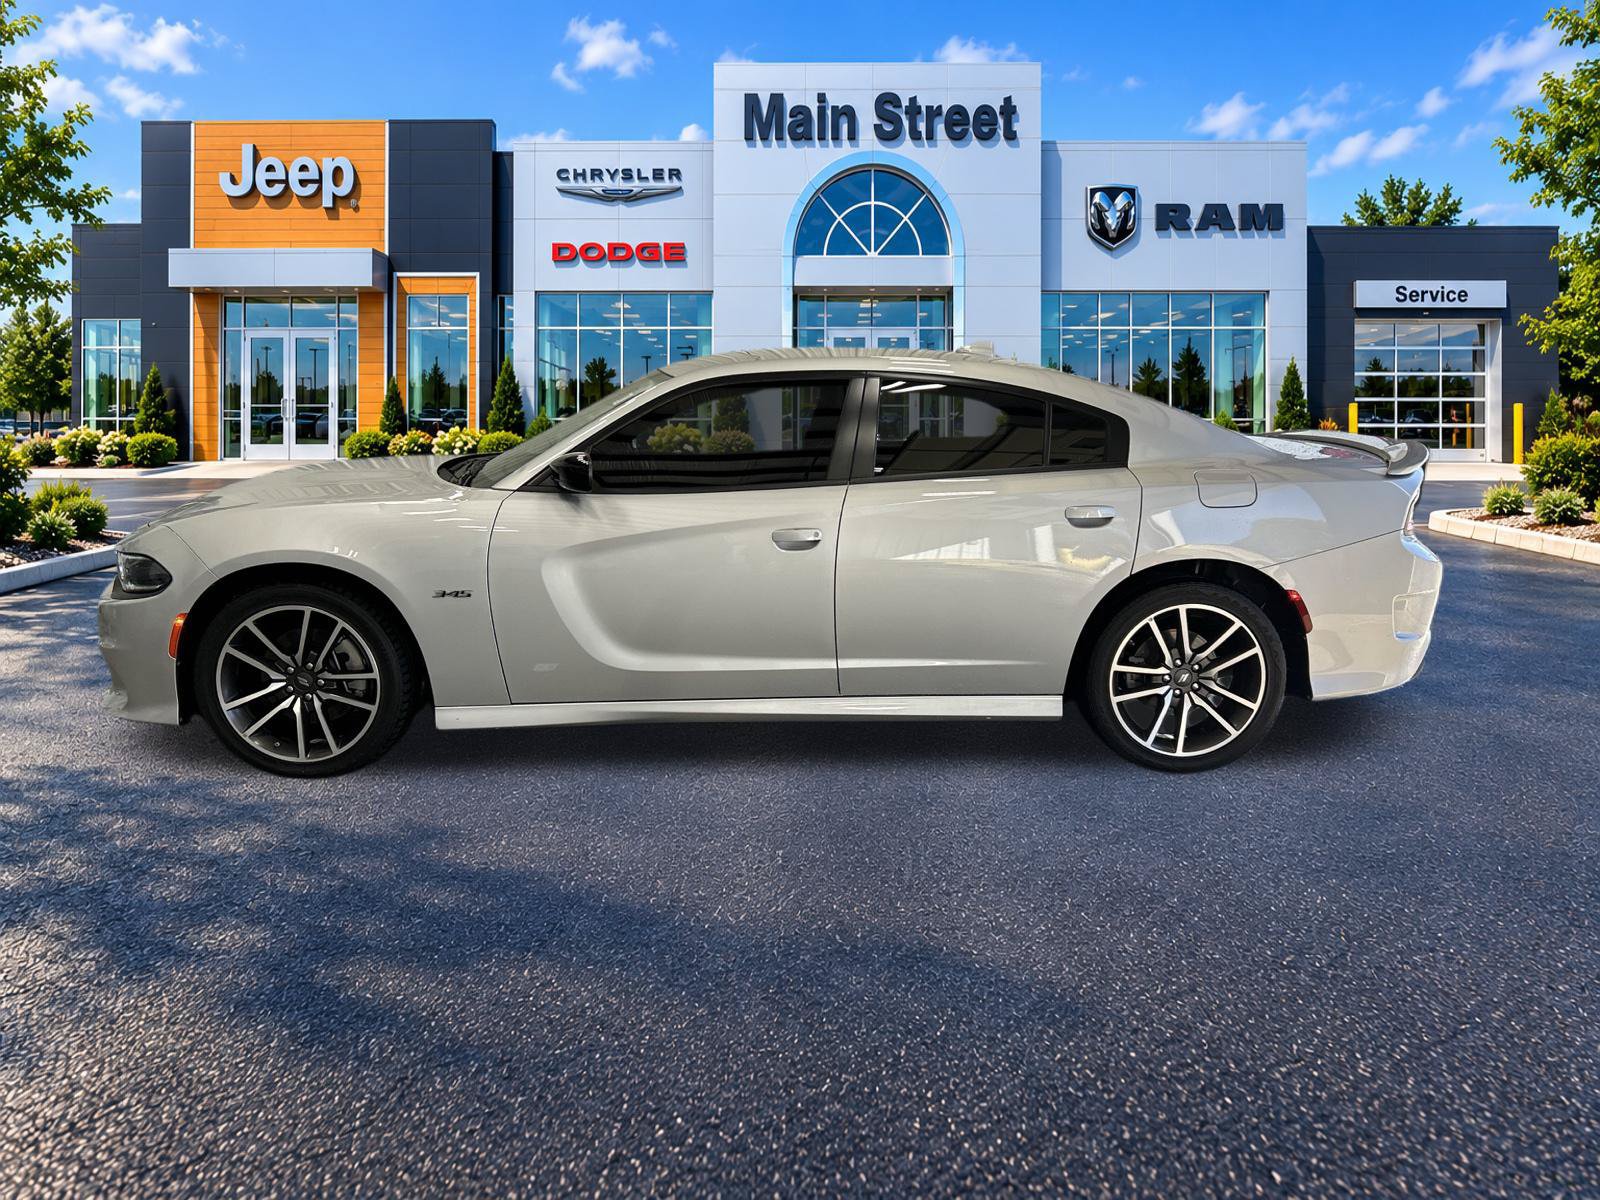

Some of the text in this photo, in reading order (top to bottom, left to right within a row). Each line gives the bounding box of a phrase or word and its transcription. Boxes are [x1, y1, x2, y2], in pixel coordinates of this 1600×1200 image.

[744, 92, 1017, 141] Main Street
[219, 144, 355, 208] Jeep
[556, 168, 682, 182] CHRYSLER
[1155, 203, 1284, 231] RAM
[552, 243, 686, 261] DODGE
[1395, 286, 1469, 302] Service
[432, 590, 473, 598] 345
